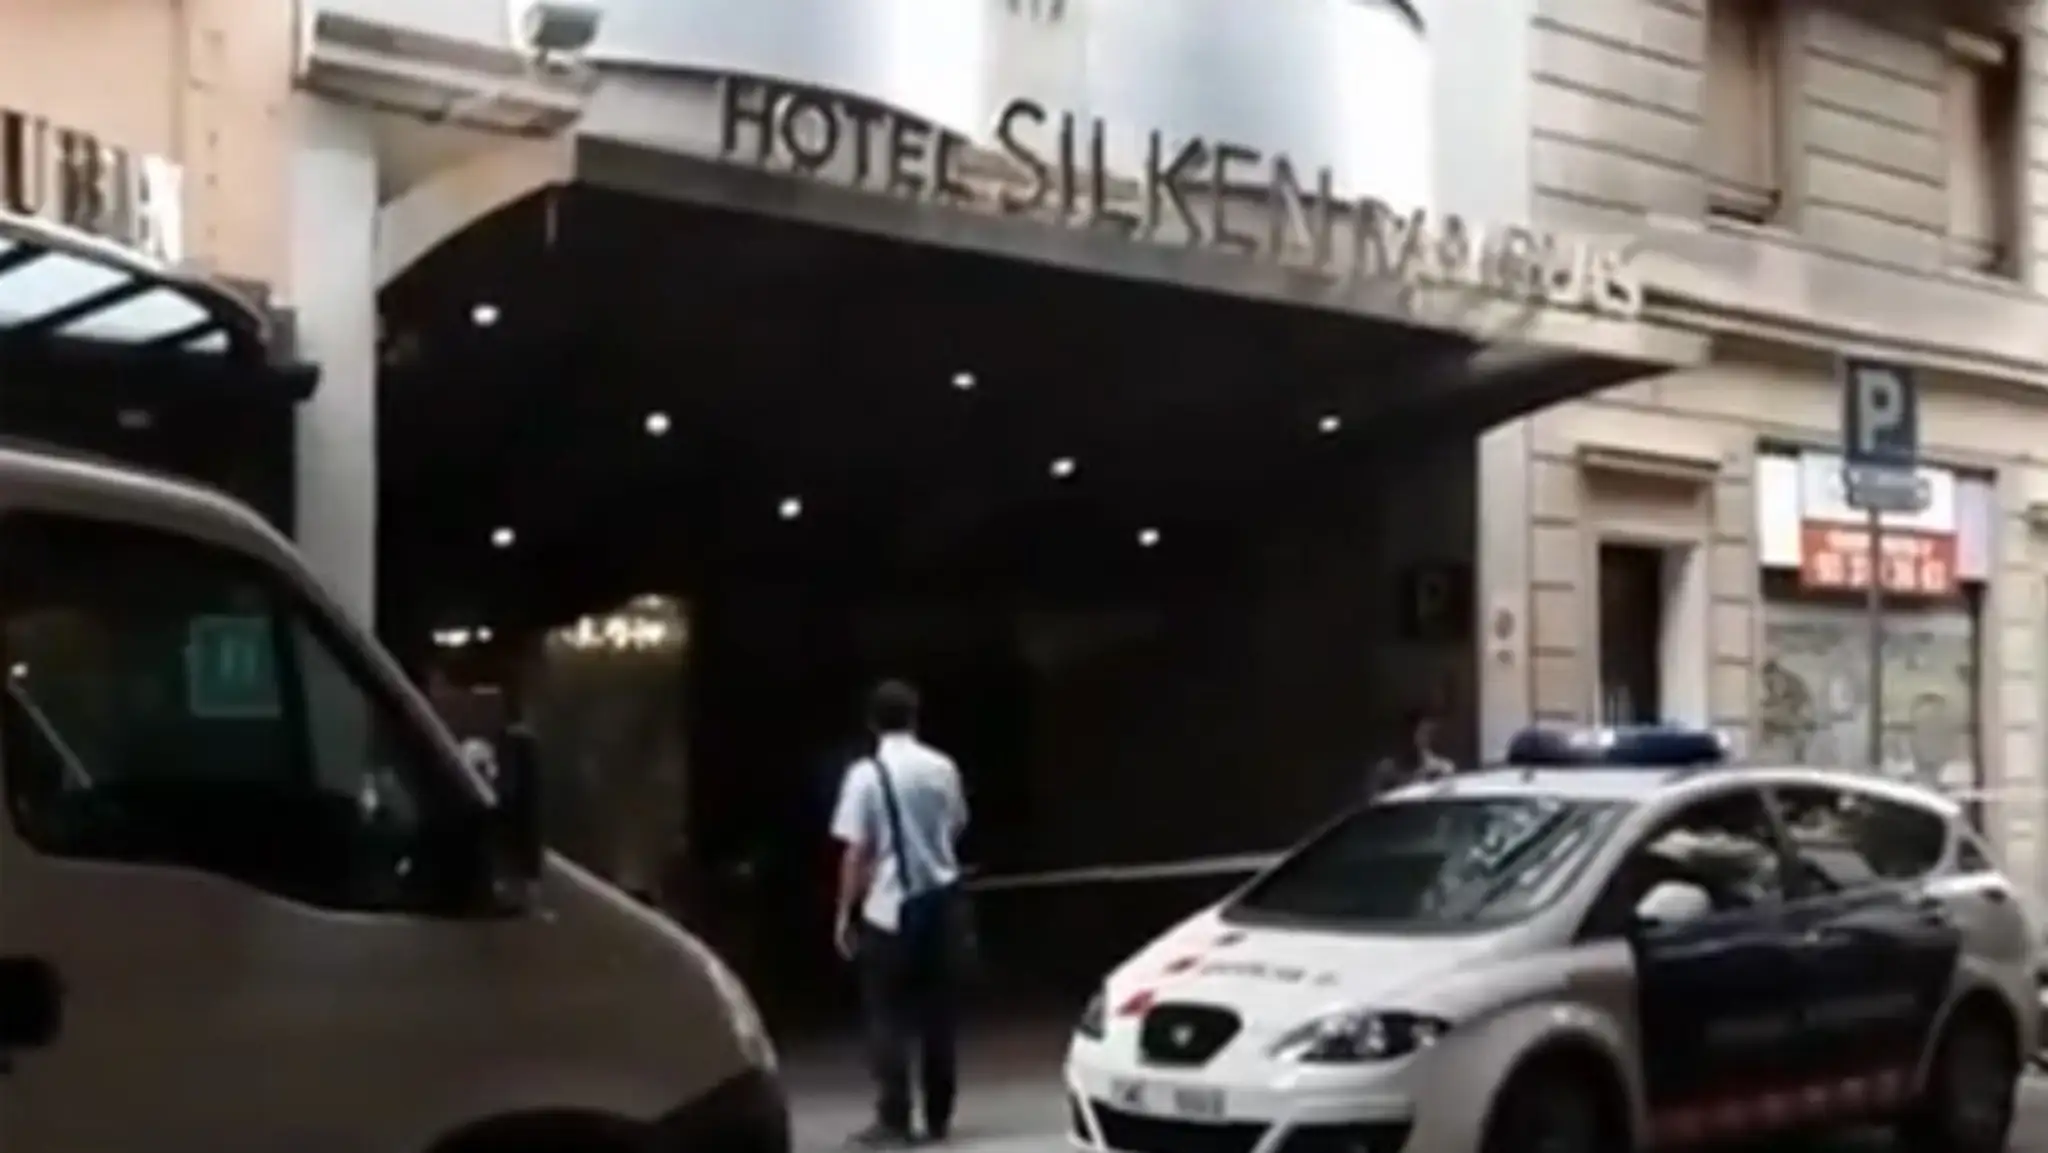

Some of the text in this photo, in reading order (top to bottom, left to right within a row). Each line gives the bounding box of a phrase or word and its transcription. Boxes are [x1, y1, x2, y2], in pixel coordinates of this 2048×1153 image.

[722, 74, 976, 201] HOTEL
[996, 97, 1337, 276] SILKEN
[1857, 367, 1905, 454] P
